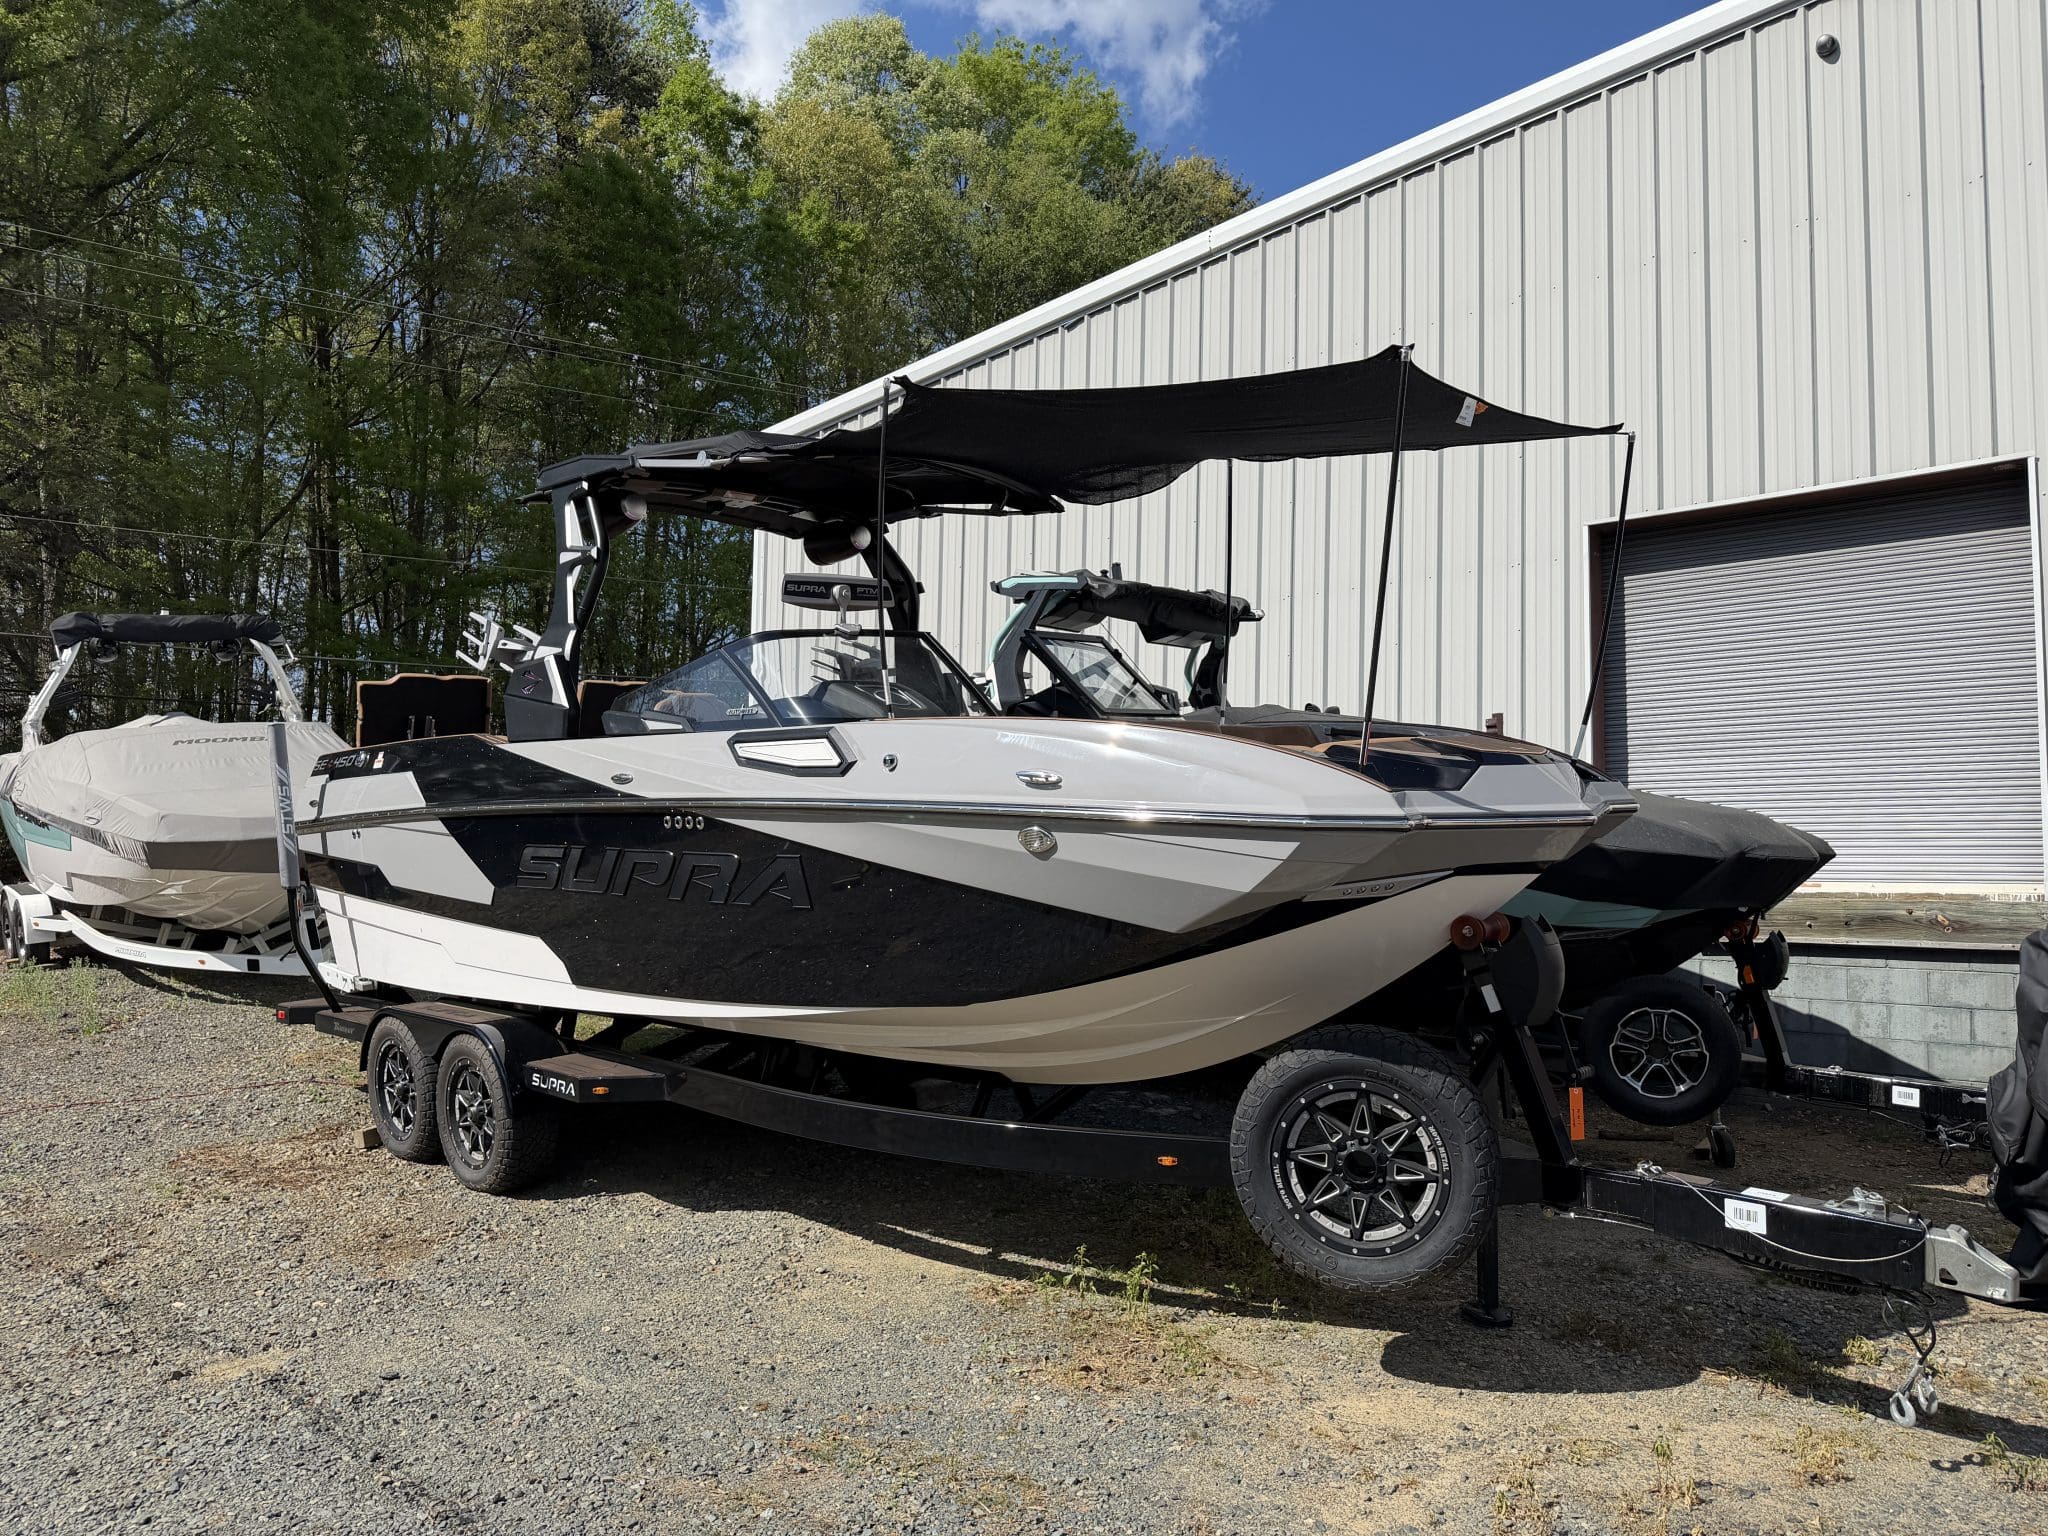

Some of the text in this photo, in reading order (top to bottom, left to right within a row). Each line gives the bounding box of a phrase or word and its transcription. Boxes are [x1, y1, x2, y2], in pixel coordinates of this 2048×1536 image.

[786, 584, 826, 593] SUPRA
[172, 736, 269, 745] MOOMB
[516, 843, 814, 909] SUPRA
[531, 1073, 576, 1097] SUPRA
[1428, 1125, 1443, 1147] MOTO
[1279, 1189, 1294, 1209] MOTO
